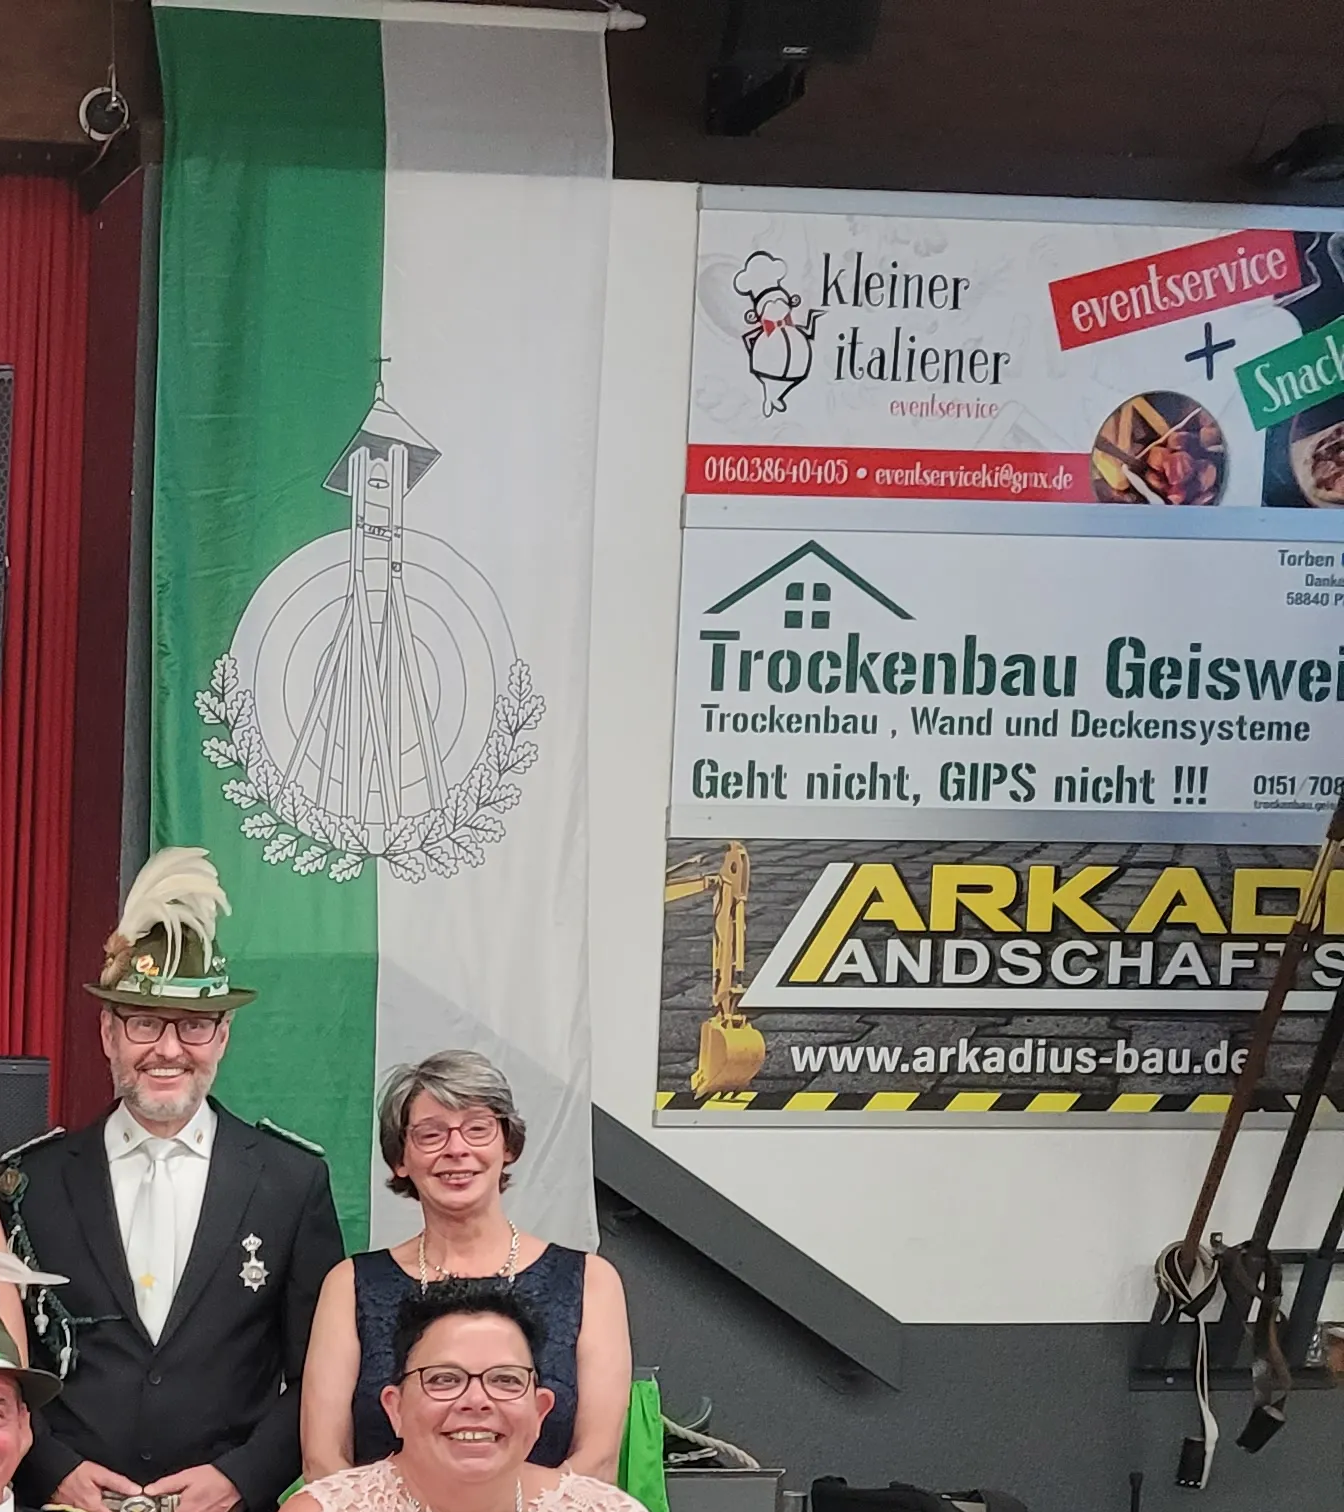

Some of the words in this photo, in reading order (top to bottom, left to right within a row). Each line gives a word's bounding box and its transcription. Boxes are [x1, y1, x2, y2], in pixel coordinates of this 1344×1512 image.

[821, 251, 970, 310] kleiner
[1071, 246, 1288, 333] eventservice
[834, 326, 1011, 385] italiener
[890, 393, 999, 419] eventservice
[874, 461, 1073, 494] eventserviceki@gmx.de
[1278, 549, 1335, 567] Torben
[1286, 592, 1330, 606] 58840
[699, 630, 1077, 697] Trockenbau
[700, 703, 878, 735] Trockenbau
[911, 707, 993, 737] Wand
[1005, 708, 1058, 739] und
[1070, 710, 1311, 746] Deckensysteme
[691, 758, 788, 799] Geht
[806, 762, 921, 807] nicht,
[939, 762, 1036, 803] GIPS
[1054, 765, 1156, 804] nicht
[790, 1036, 1249, 1077] www.arkadius-bau.de
